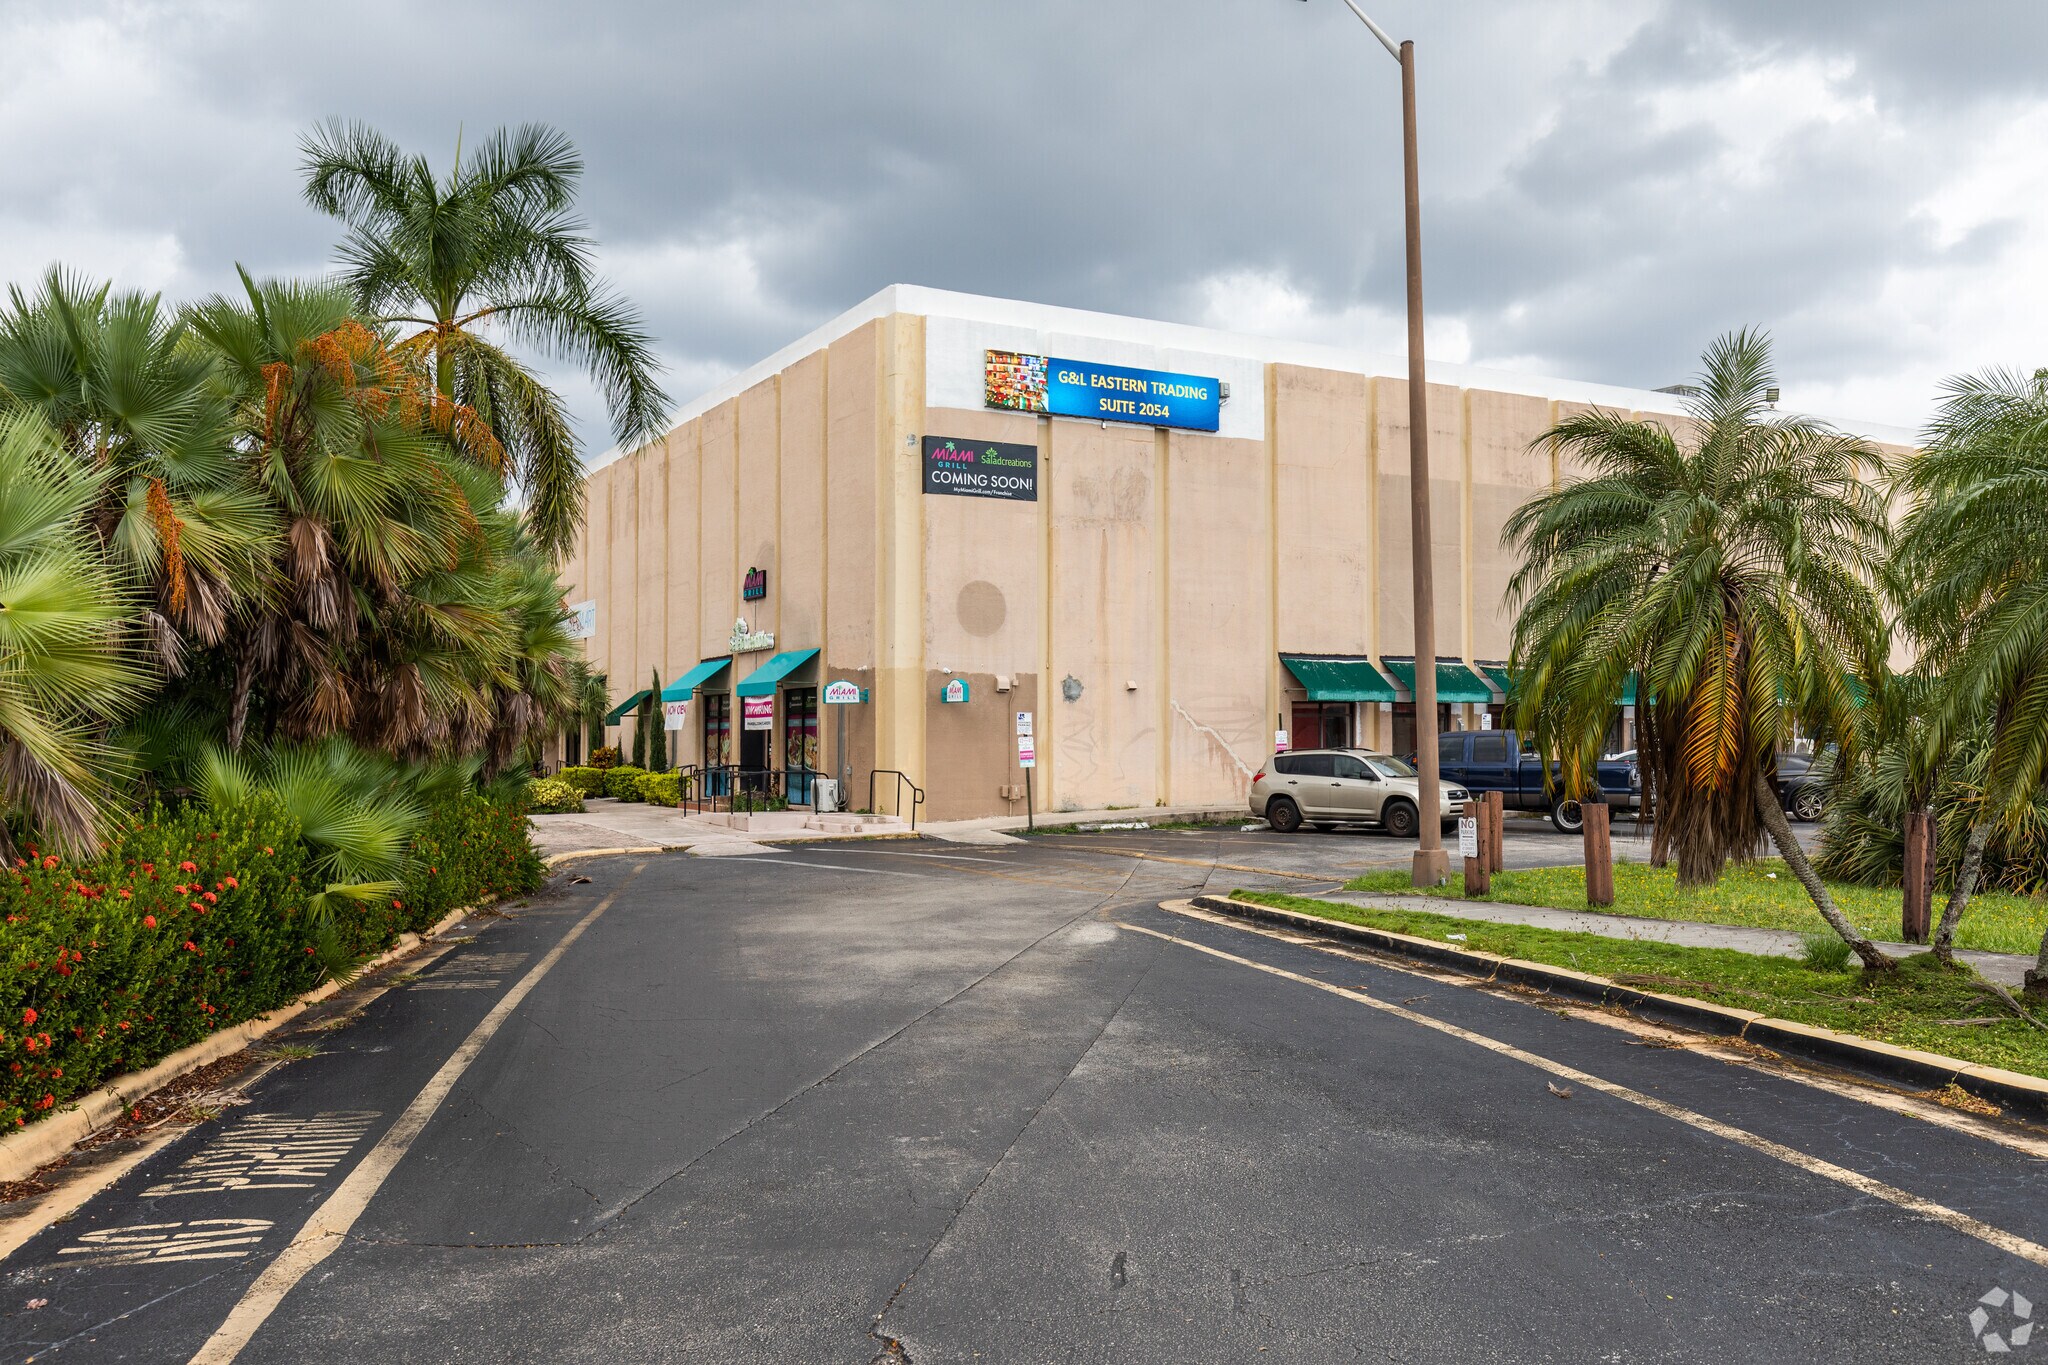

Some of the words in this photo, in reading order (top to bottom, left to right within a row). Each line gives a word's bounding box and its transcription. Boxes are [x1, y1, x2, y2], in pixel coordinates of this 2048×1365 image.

[1058, 370, 1087, 386] G&L
[1090, 374, 1147, 393] EASTERN
[1151, 381, 1208, 400] TRADING
[1099, 398, 1136, 414] SUITE
[1139, 402, 1170, 418] 2054
[931, 447, 974, 463] MIAMI
[937, 461, 968, 470] GRILL
[931, 470, 988, 487] COMING
[990, 475, 1033, 490] SOON!
[744, 587, 763, 598] GRILL
[830, 688, 857, 696] MIAMI
[1461, 820, 1474, 829] NO
